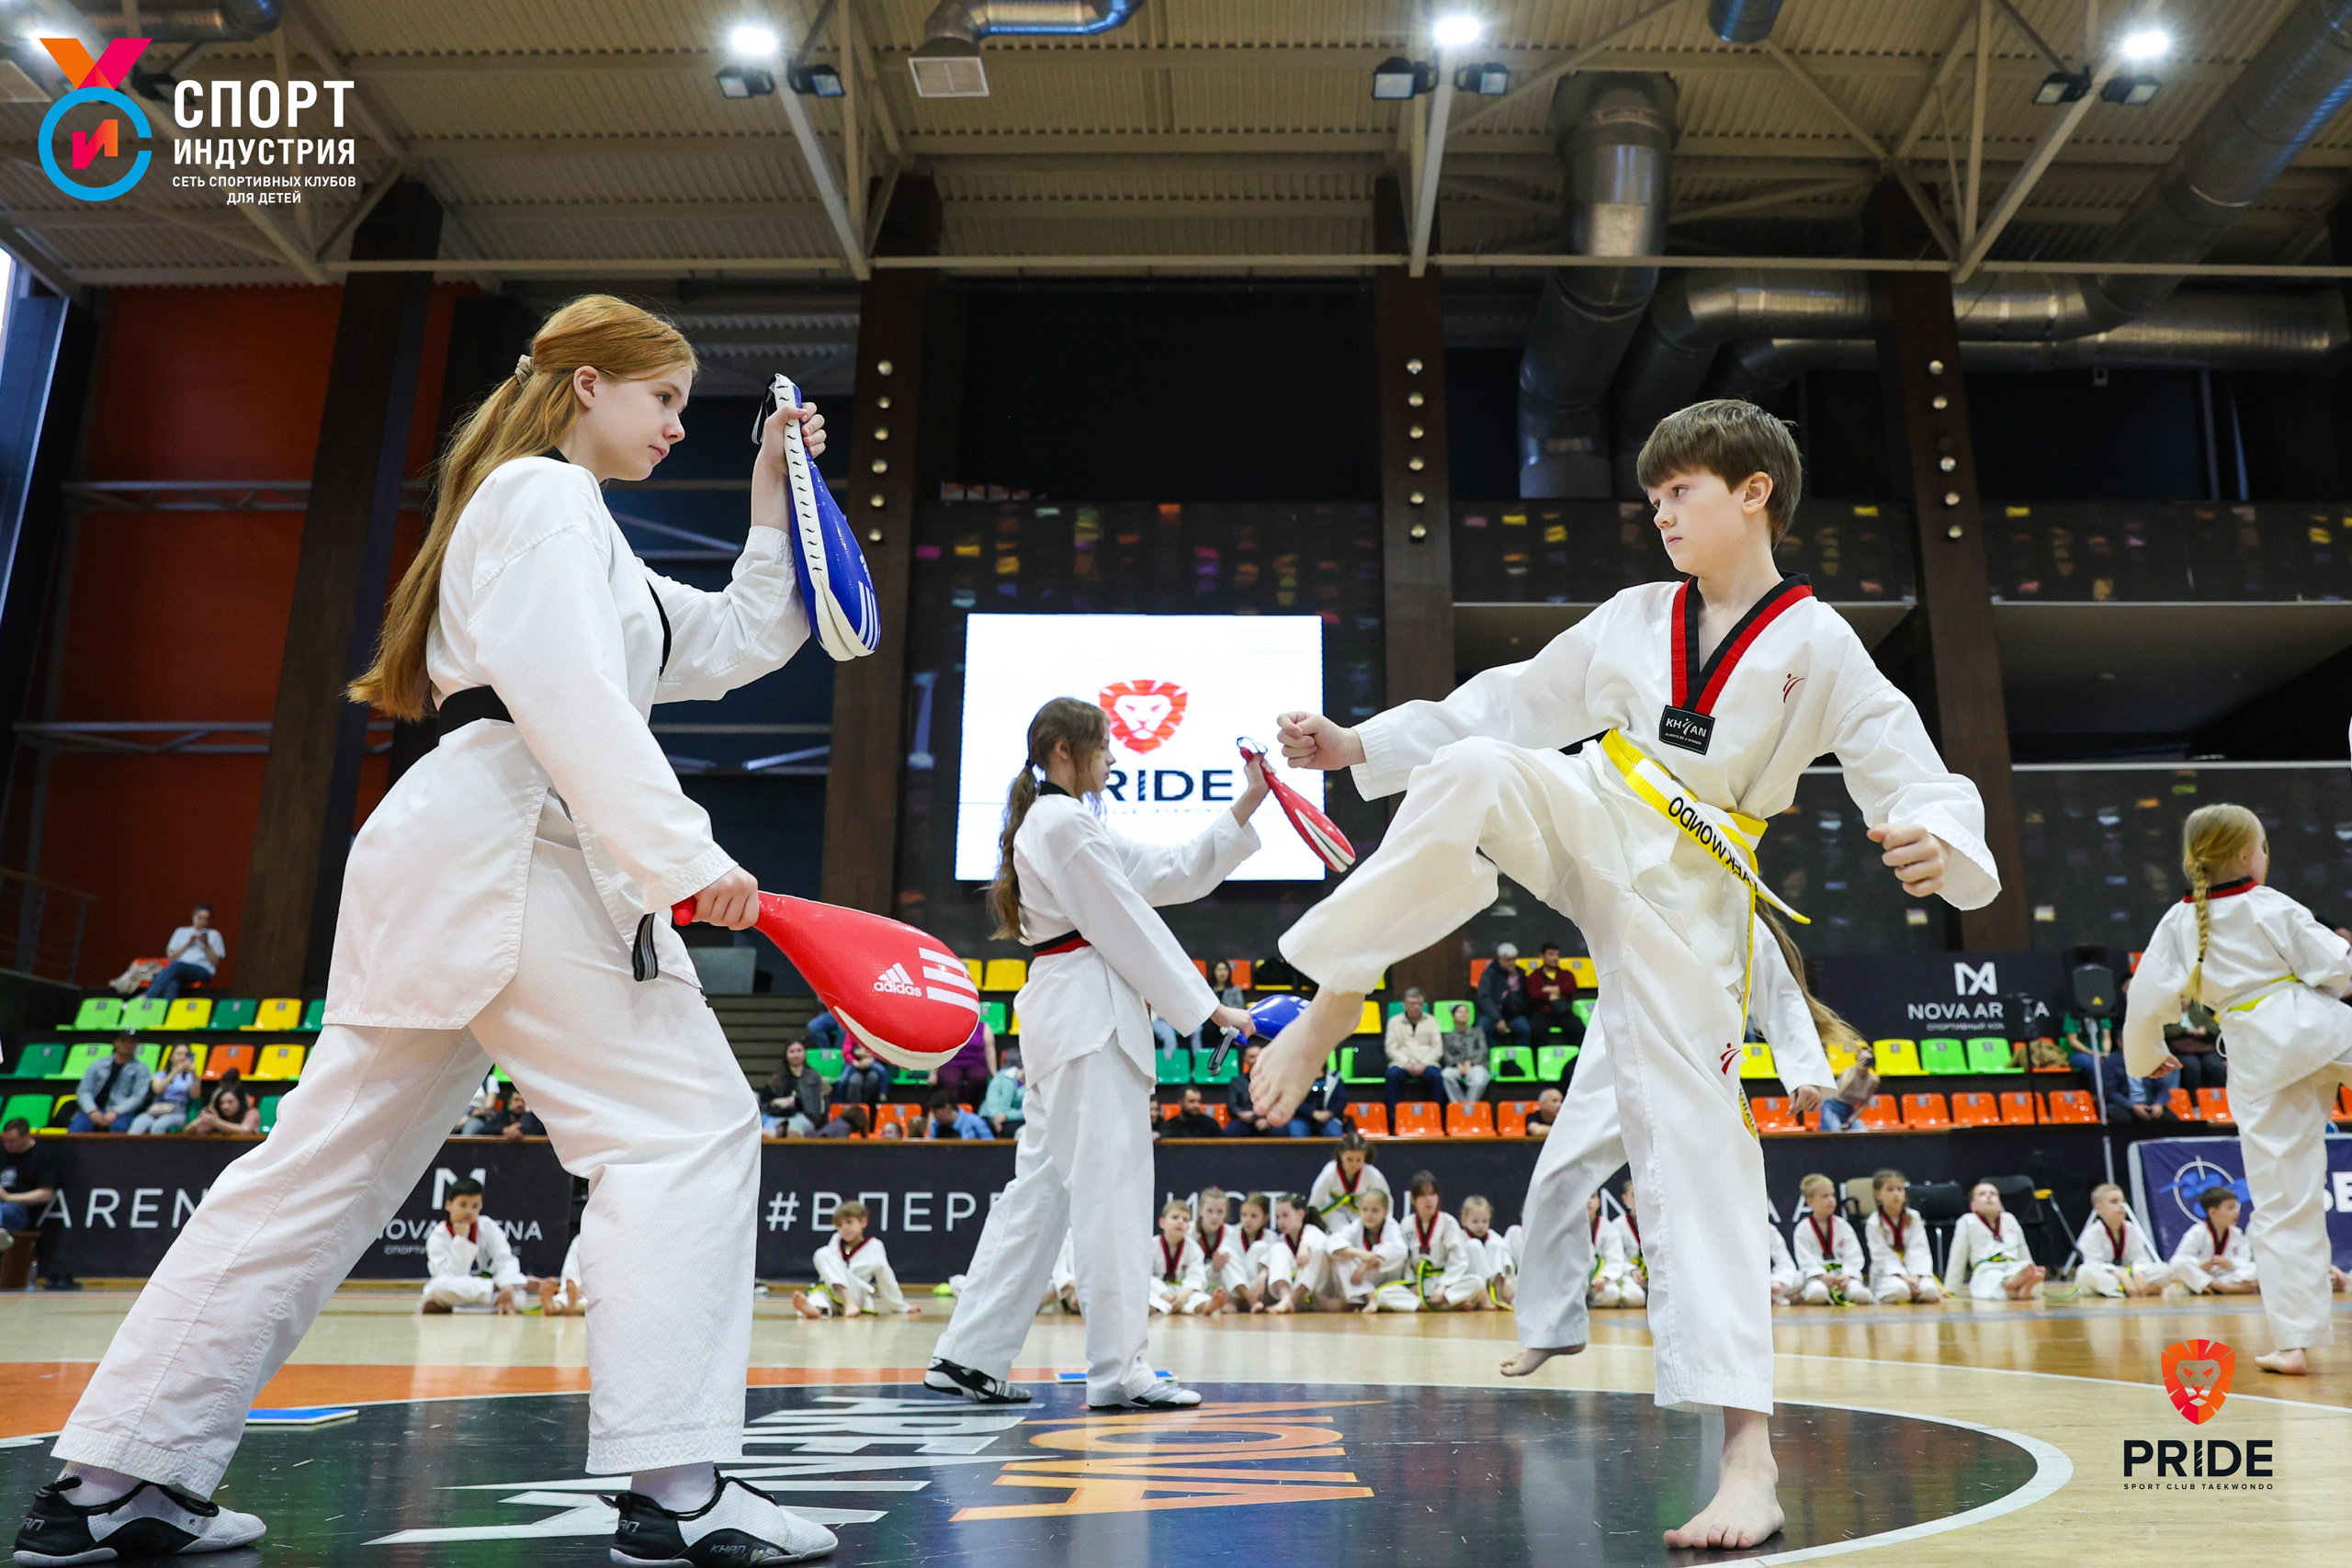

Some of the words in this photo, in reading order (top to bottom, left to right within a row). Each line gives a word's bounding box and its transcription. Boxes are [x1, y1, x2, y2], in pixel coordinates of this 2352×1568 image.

[1106, 770, 1233, 801] RIDE
[874, 981, 922, 998] adidas
[1907, 1002, 1971, 1021] NOVA
[1973, 1001, 2050, 1020] ARA
[36, 1188, 209, 1229] AREN
[765, 1191, 1007, 1232] #ВПЕР
